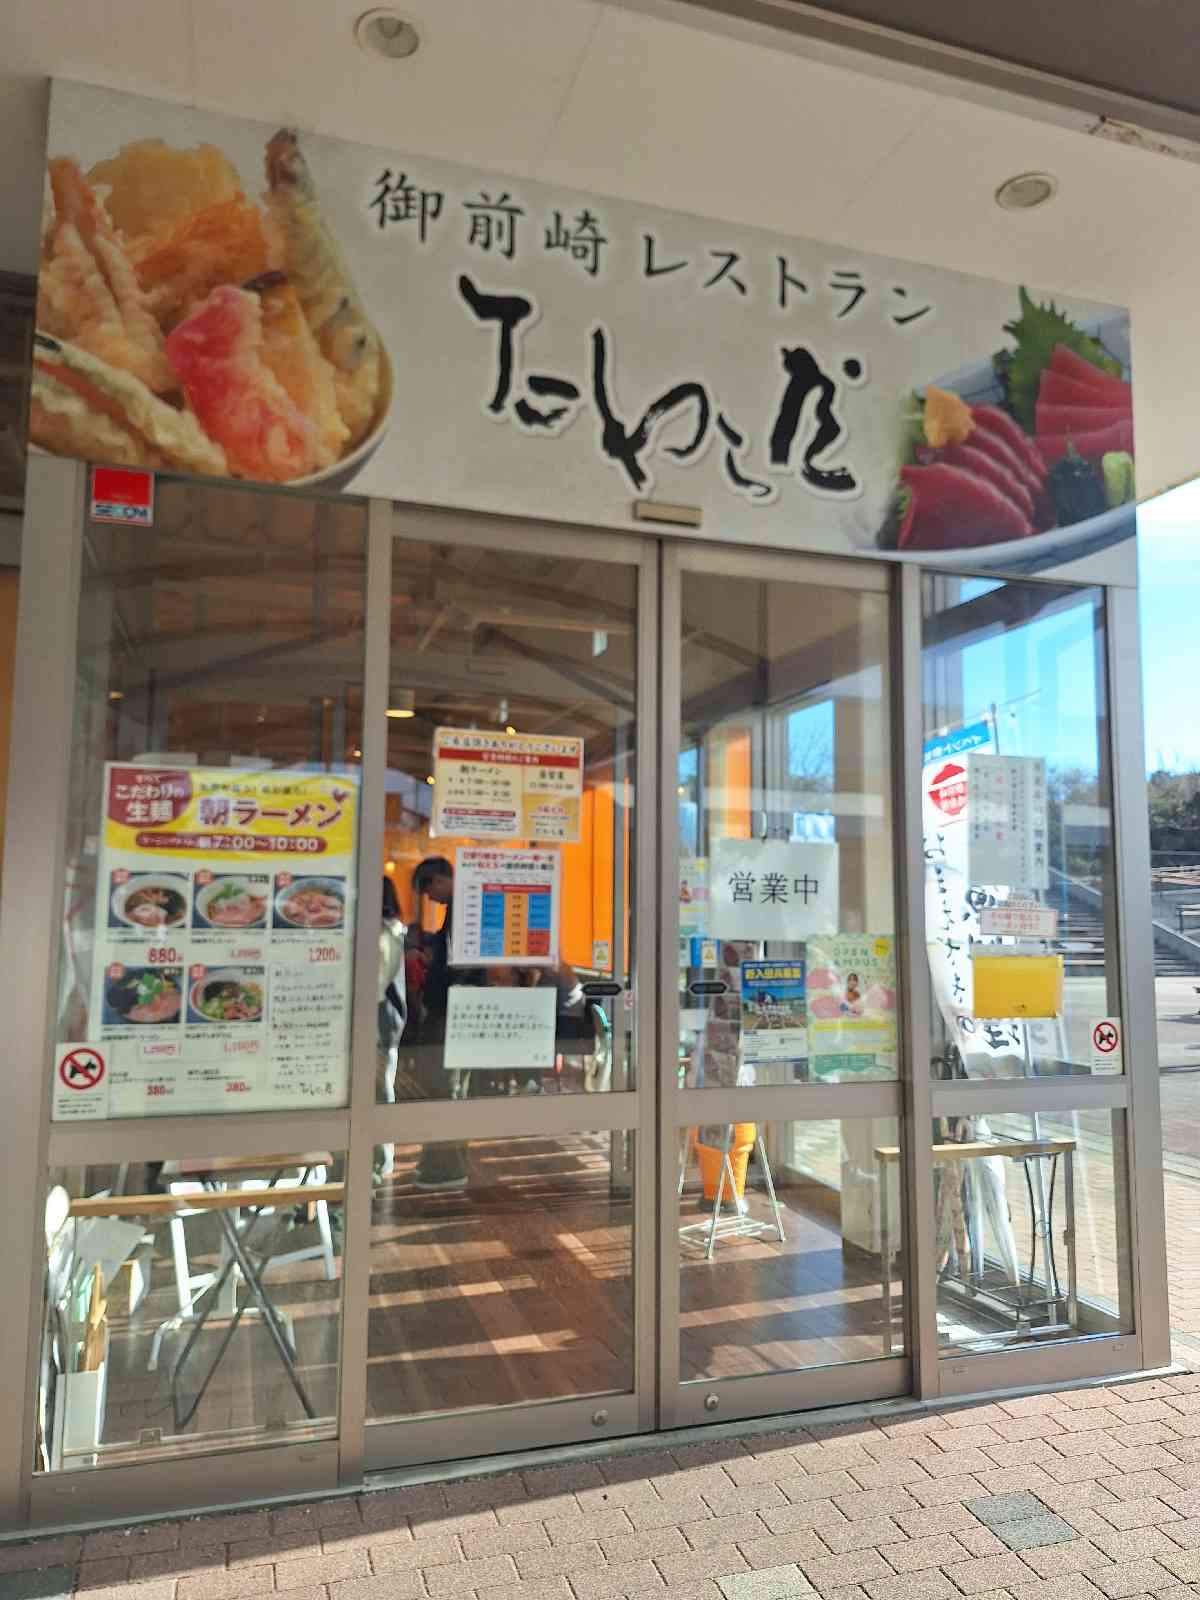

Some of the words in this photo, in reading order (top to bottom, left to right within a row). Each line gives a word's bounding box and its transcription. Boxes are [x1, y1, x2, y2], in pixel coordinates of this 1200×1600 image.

[114, 784, 186, 801] こだわりの
[198, 795, 342, 828] 朝ラーメン
[727, 871, 820, 905] 営業中
